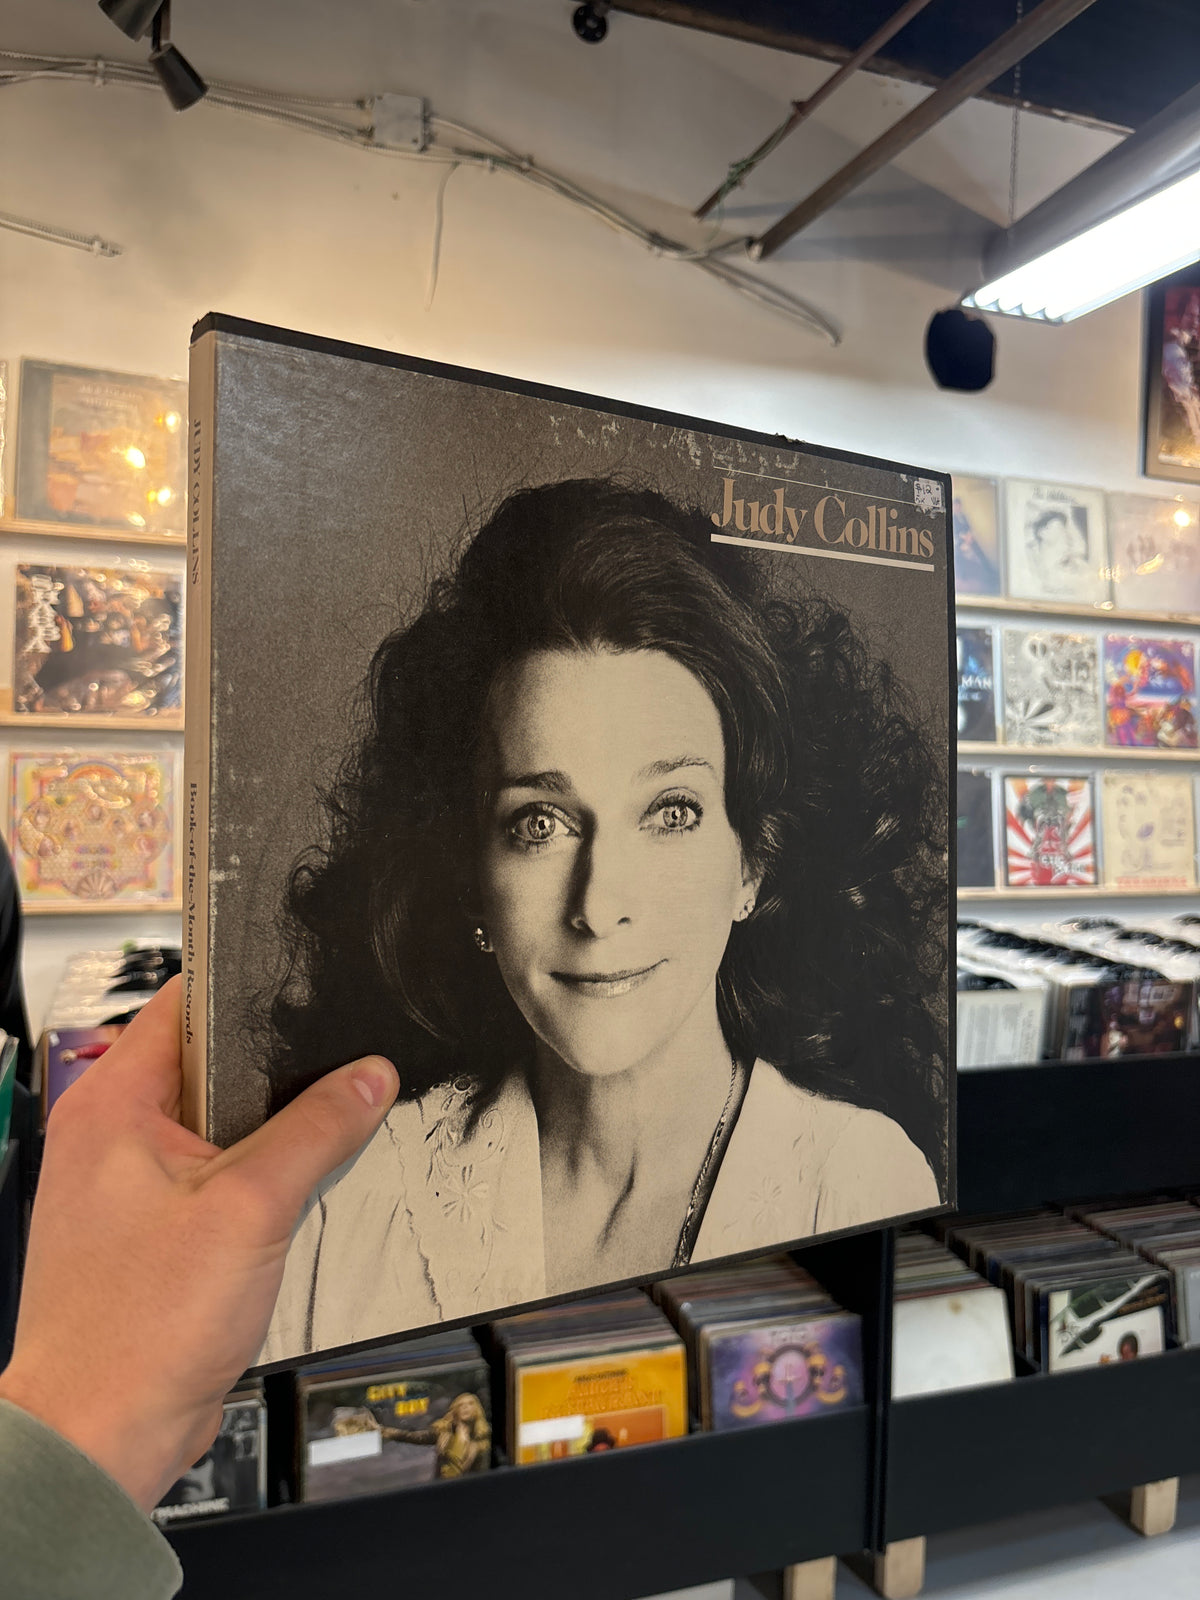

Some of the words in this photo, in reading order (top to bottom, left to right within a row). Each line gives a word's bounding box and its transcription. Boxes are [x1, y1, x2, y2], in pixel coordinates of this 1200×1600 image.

[193, 418, 202, 476] JUDY
[191, 481, 201, 585] COLLINS
[710, 477, 809, 544] Judy
[813, 494, 935, 558] Collins
[187, 782, 198, 962] Book-of-the-Month
[185, 968, 195, 1045] Records
